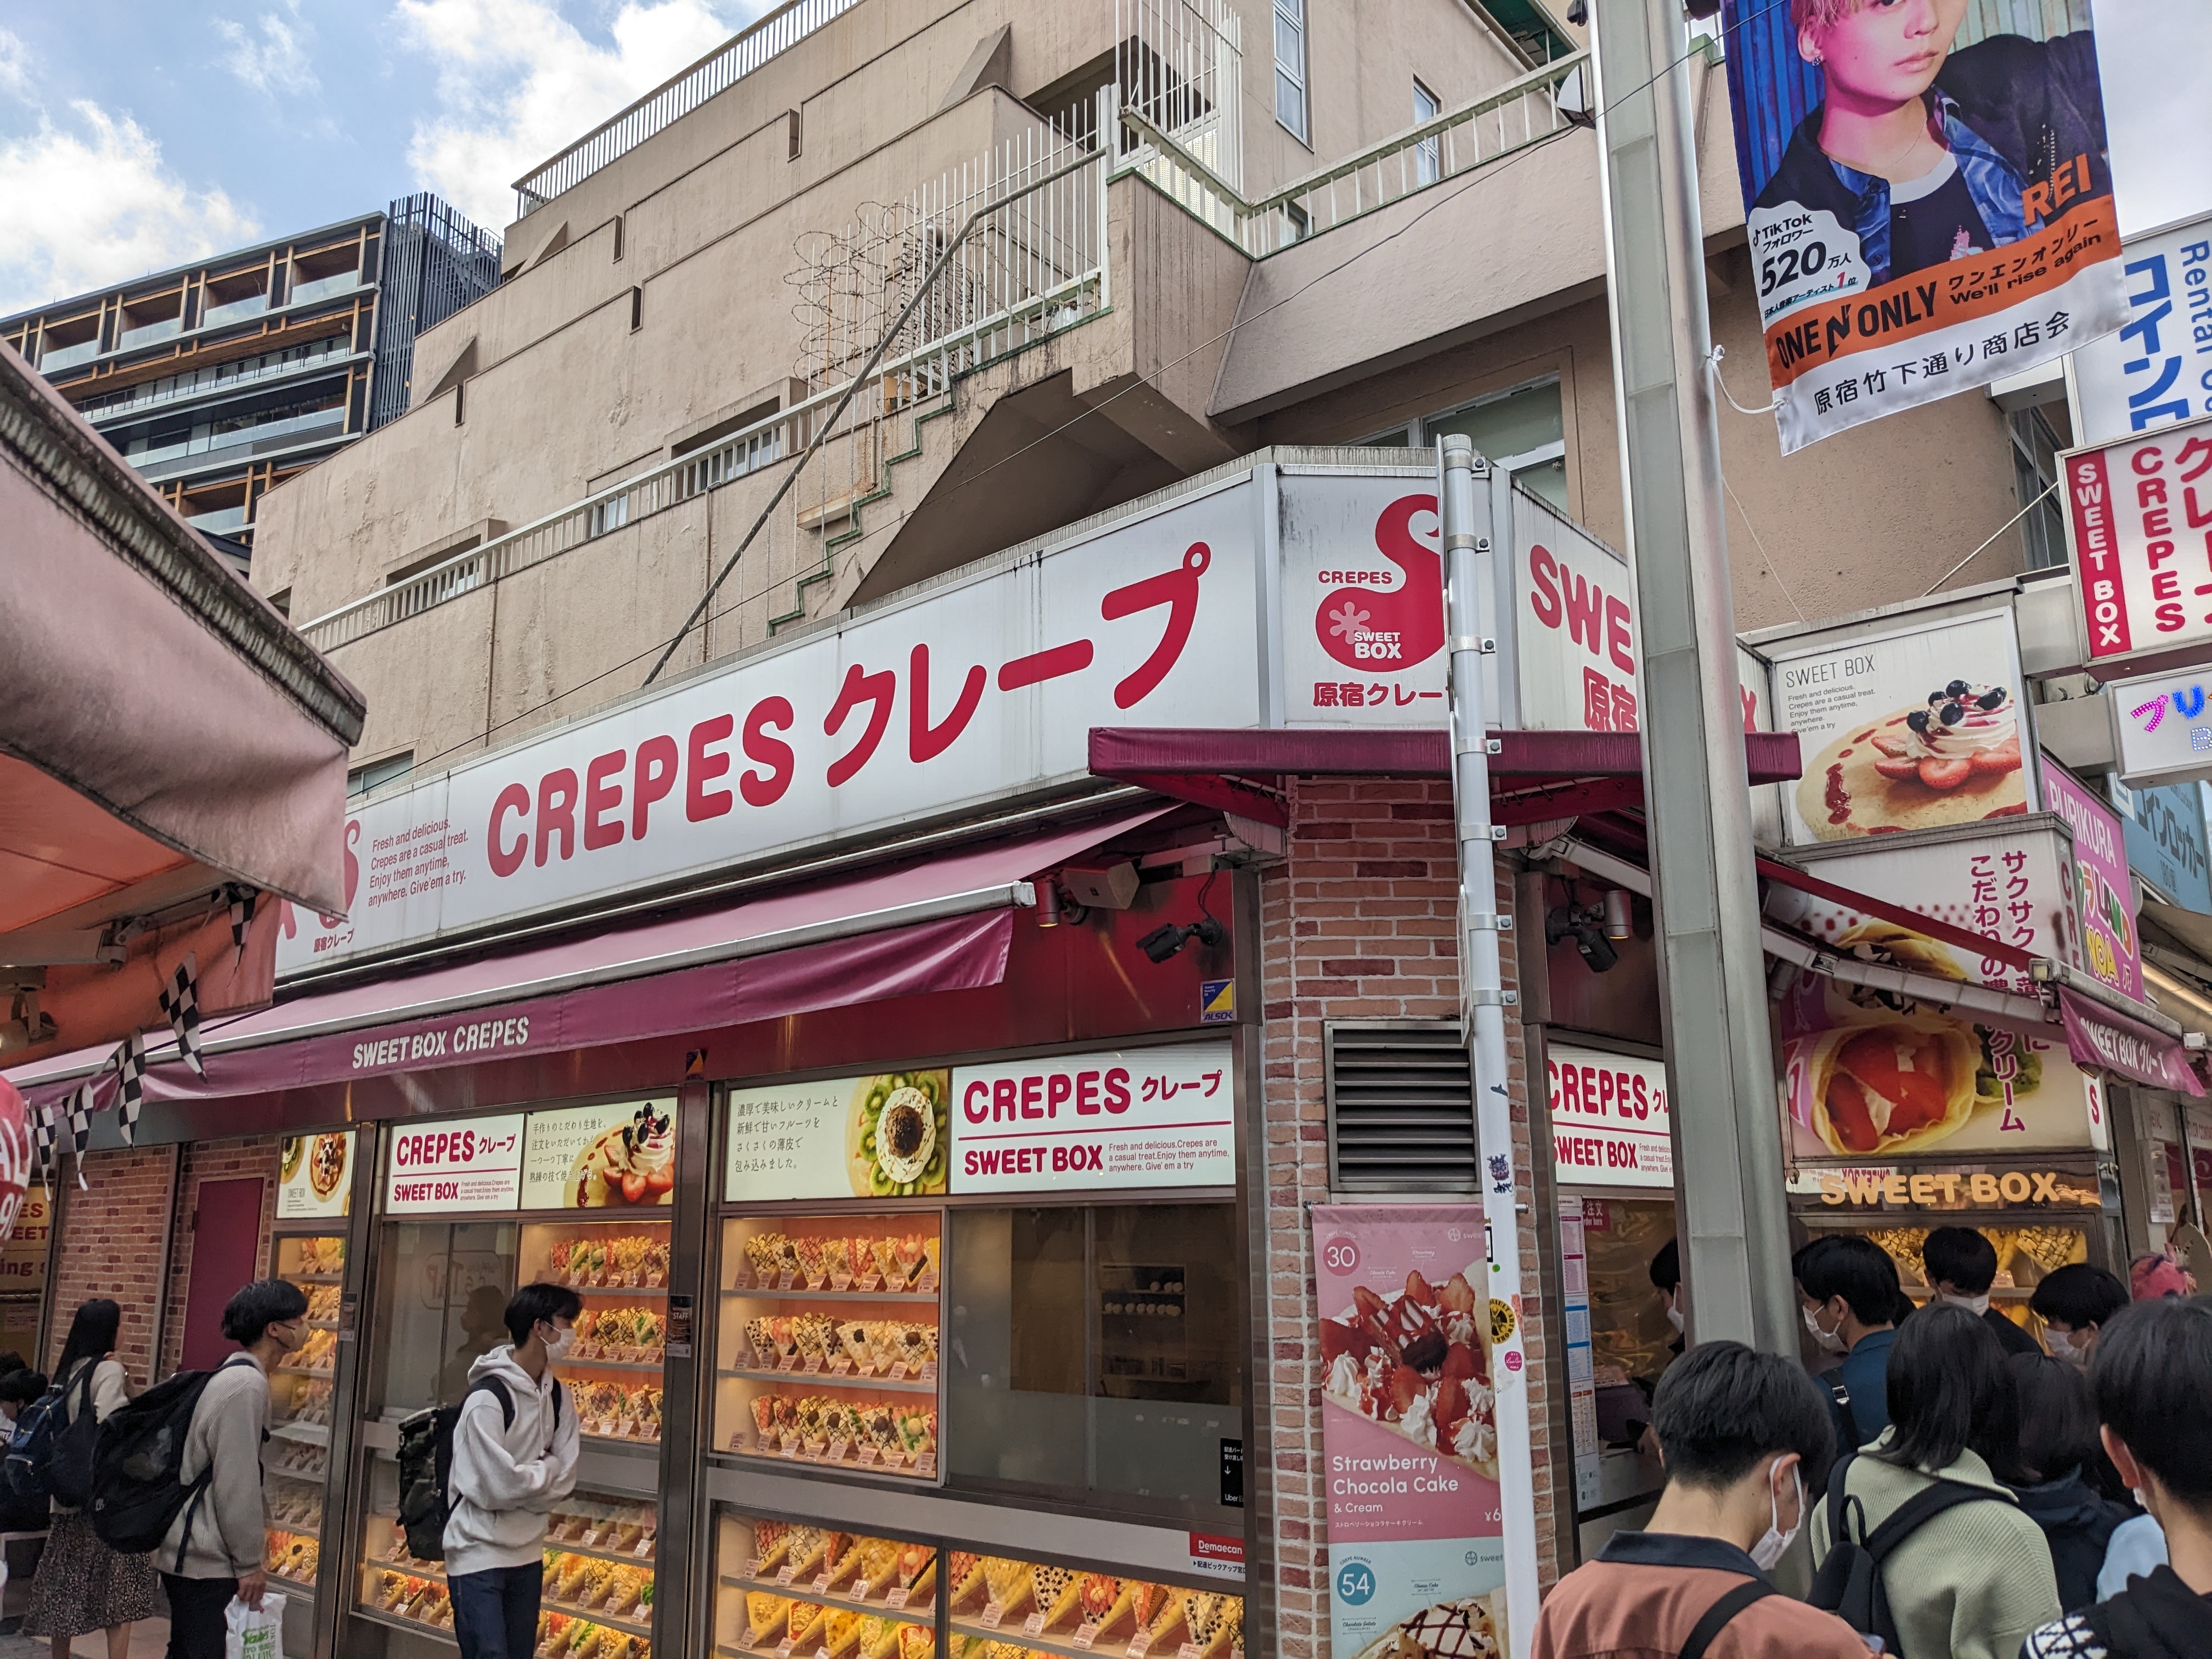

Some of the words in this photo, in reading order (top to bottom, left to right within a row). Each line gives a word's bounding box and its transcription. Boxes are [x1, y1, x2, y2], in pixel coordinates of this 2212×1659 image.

[2022, 153, 2092, 227] REI
[1762, 214, 1813, 240] TikTok
[1763, 229, 1814, 254] フォロワー
[1948, 219, 2098, 287] ワンエンオンリー
[1950, 283, 2000, 306] We'll
[2007, 266, 2047, 290] rise
[2054, 234, 2101, 268] again
[1776, 318, 1821, 370] ONE
[1858, 281, 1940, 336] ONLY
[1814, 311, 2069, 416] 原宿竹下通り商店会
[2131, 447, 2185, 632] CREPES
[2076, 463, 2108, 571] SWEET
[2093, 579, 2121, 647] BOX
[1318, 570, 1392, 584] CREPES
[1353, 631, 1401, 642] SWEET
[1354, 642, 1402, 659] BOX
[1786, 662, 1837, 688] SWEET
[1844, 654, 1875, 677] BOX
[1312, 682, 1449, 708] 原宿クレー
[1787, 693, 1807, 702] Fresh
[1809, 690, 1822, 698] and
[1823, 685, 1855, 696] delicious.
[1788, 699, 1813, 710] Crepes
[1833, 692, 1857, 702] casual
[1858, 689, 1875, 697] treat.
[487, 695, 795, 878] CREPES
[823, 541, 1212, 788] クレープ
[1790, 710, 1809, 719] Enjoy
[1810, 706, 1827, 715] them
[1790, 716, 1825, 727] anywhere.
[2048, 778, 2117, 868] PURIKURA
[373, 836, 393, 853] Fresh
[396, 829, 410, 846] and
[412, 819, 450, 843] delicious.
[371, 853, 398, 871] Crepes
[399, 849, 411, 862] are
[413, 848, 418, 857] a
[419, 836, 445, 856] casual
[447, 830, 469, 848] treat.
[369, 872, 392, 889] Enjoy
[393, 867, 413, 883] them
[415, 856, 449, 878] anytime,
[368, 887, 408, 907] anywhere.
[445, 874, 450, 885] a
[452, 869, 466, 885] try.
[313, 928, 355, 953] 原宿クレープ
[2085, 922, 2119, 987] NOA
[1204, 1012, 1233, 1021] ALSOK
[352, 1036, 411, 1069] SWEET
[411, 1030, 447, 1060] BOX
[453, 1015, 531, 1053] CREPES
[2119, 1032, 2139, 1071] BOX
[963, 1067, 1131, 1125] CREPES
[1141, 1069, 1223, 1103] クレープ
[1549, 1059, 1649, 1121] CREPES
[737, 1096, 838, 1117] 濃厚で美味しいクリームと
[533, 1118, 606, 1135] 手作りのこだわり生地を、
[736, 1117, 820, 1135] 新鮮で甘いフルーツを
[397, 1130, 475, 1166] CREPES
[479, 1133, 517, 1154] クレープ
[532, 1135, 594, 1150] 注文をいただいてから
[737, 1137, 804, 1152] さくさくの薄皮で
[1109, 1143, 1128, 1152] Fresh
[1130, 1142, 1143, 1150] and
[531, 1153, 574, 1165] 一つ一つ丁寧に
[735, 1158, 797, 1172] 包み込みました。
[964, 1145, 1049, 1176] SWEET
[1052, 1144, 1103, 1172] BOX
[1109, 1163, 1144, 1172] anywhere.
[1183, 1161, 1194, 1170] try
[1115, 1153, 1136, 1161] casual
[1178, 1149, 1196, 1158] them
[1607, 1141, 1638, 1169] BOX
[394, 1183, 433, 1201] SWEET
[435, 1182, 459, 1200] BOX
[1820, 1172, 1961, 1206] SWEET
[1970, 1171, 2061, 1204] BOX
[1327, 1246, 1355, 1267] 30
[1332, 1453, 1438, 1474] Strawberry
[1224, 1493, 1238, 1502] Uber
[1333, 1478, 1408, 1496] Chocola
[1414, 1475, 1459, 1493] Cake
[1334, 1503, 1342, 1513] &
[1345, 1503, 1383, 1513] Cream
[1198, 1539, 1243, 1555] Demaecan
[1339, 1556, 1353, 1565] CREPE
[1341, 1573, 1370, 1596] 54
